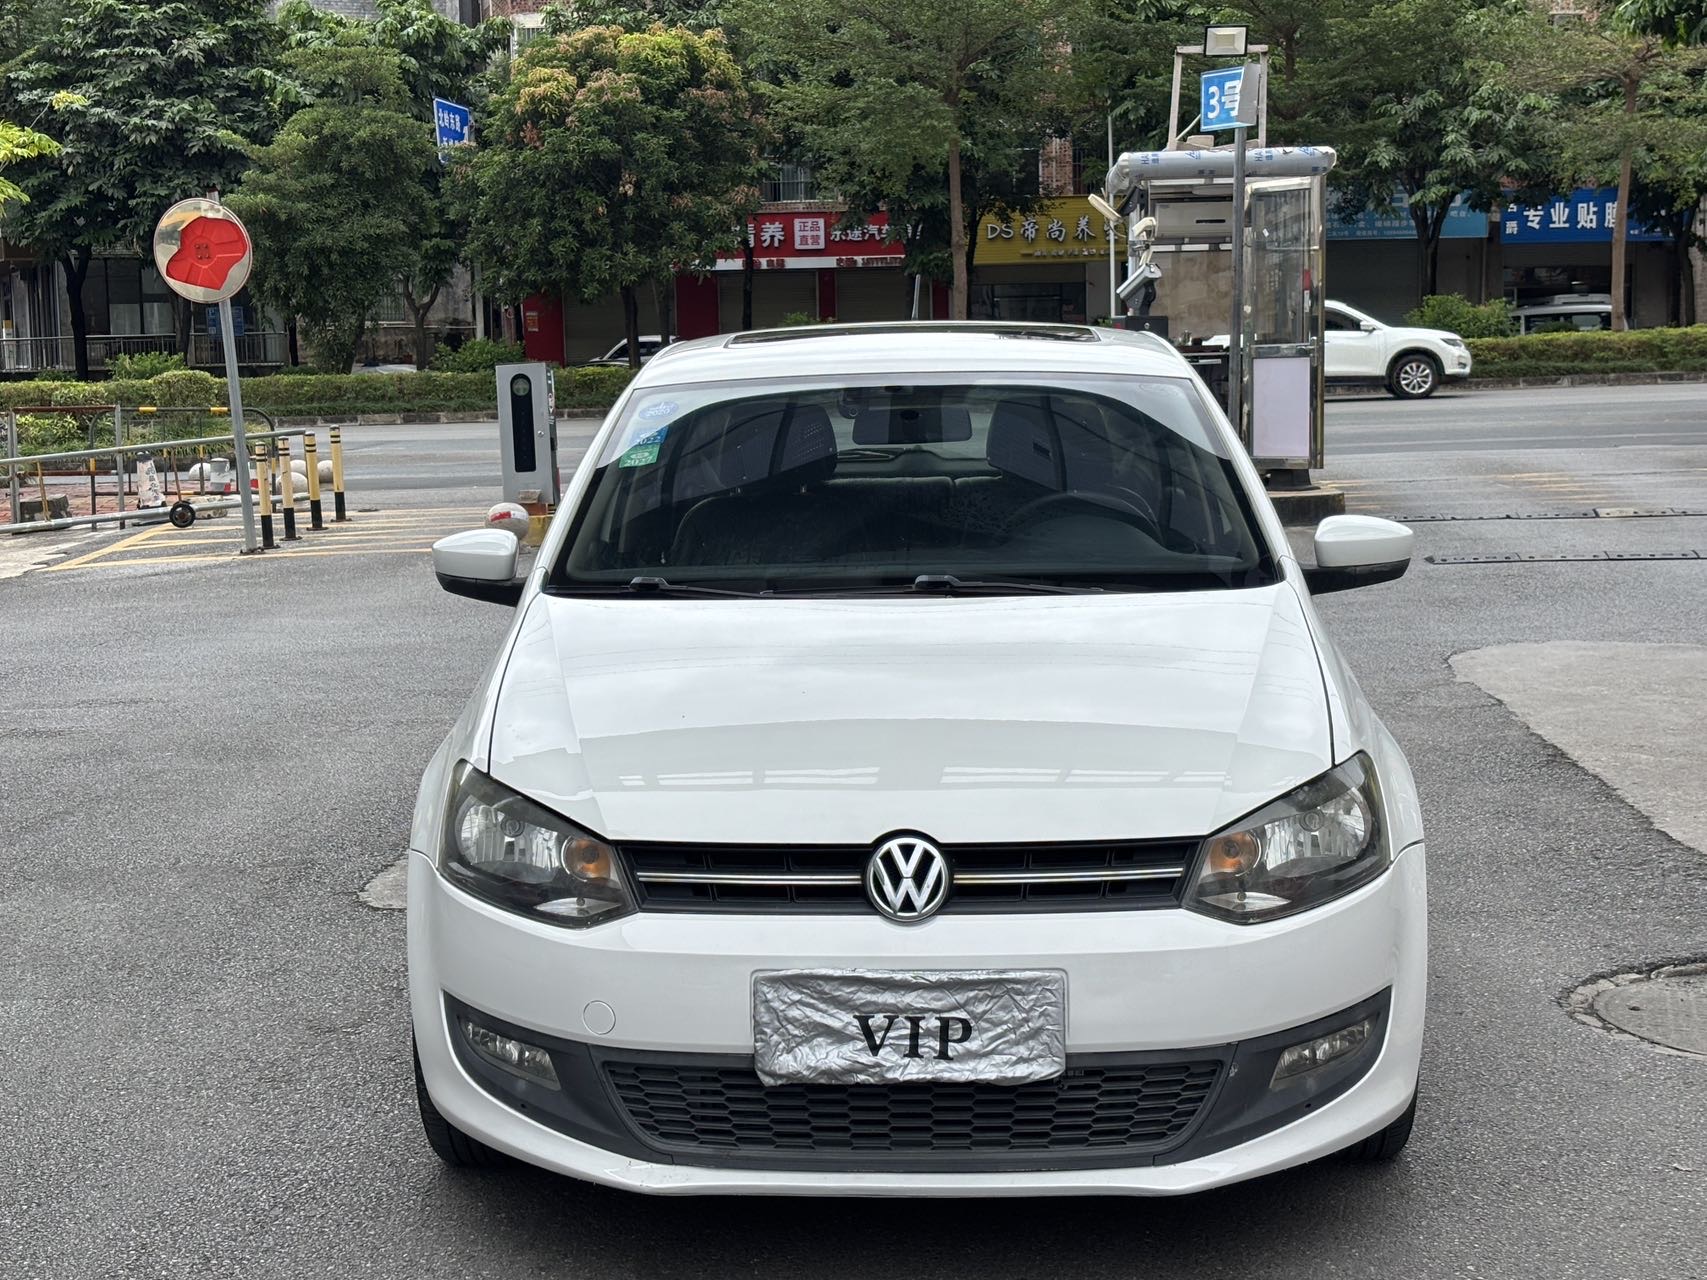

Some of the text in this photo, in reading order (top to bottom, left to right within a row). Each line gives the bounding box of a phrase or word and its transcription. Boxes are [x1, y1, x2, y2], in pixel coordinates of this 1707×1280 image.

[1207, 80, 1241, 119] 3号
[798, 220, 821, 233] 正品
[798, 234, 821, 247] 直营
[853, 1014, 973, 1061] VIP
